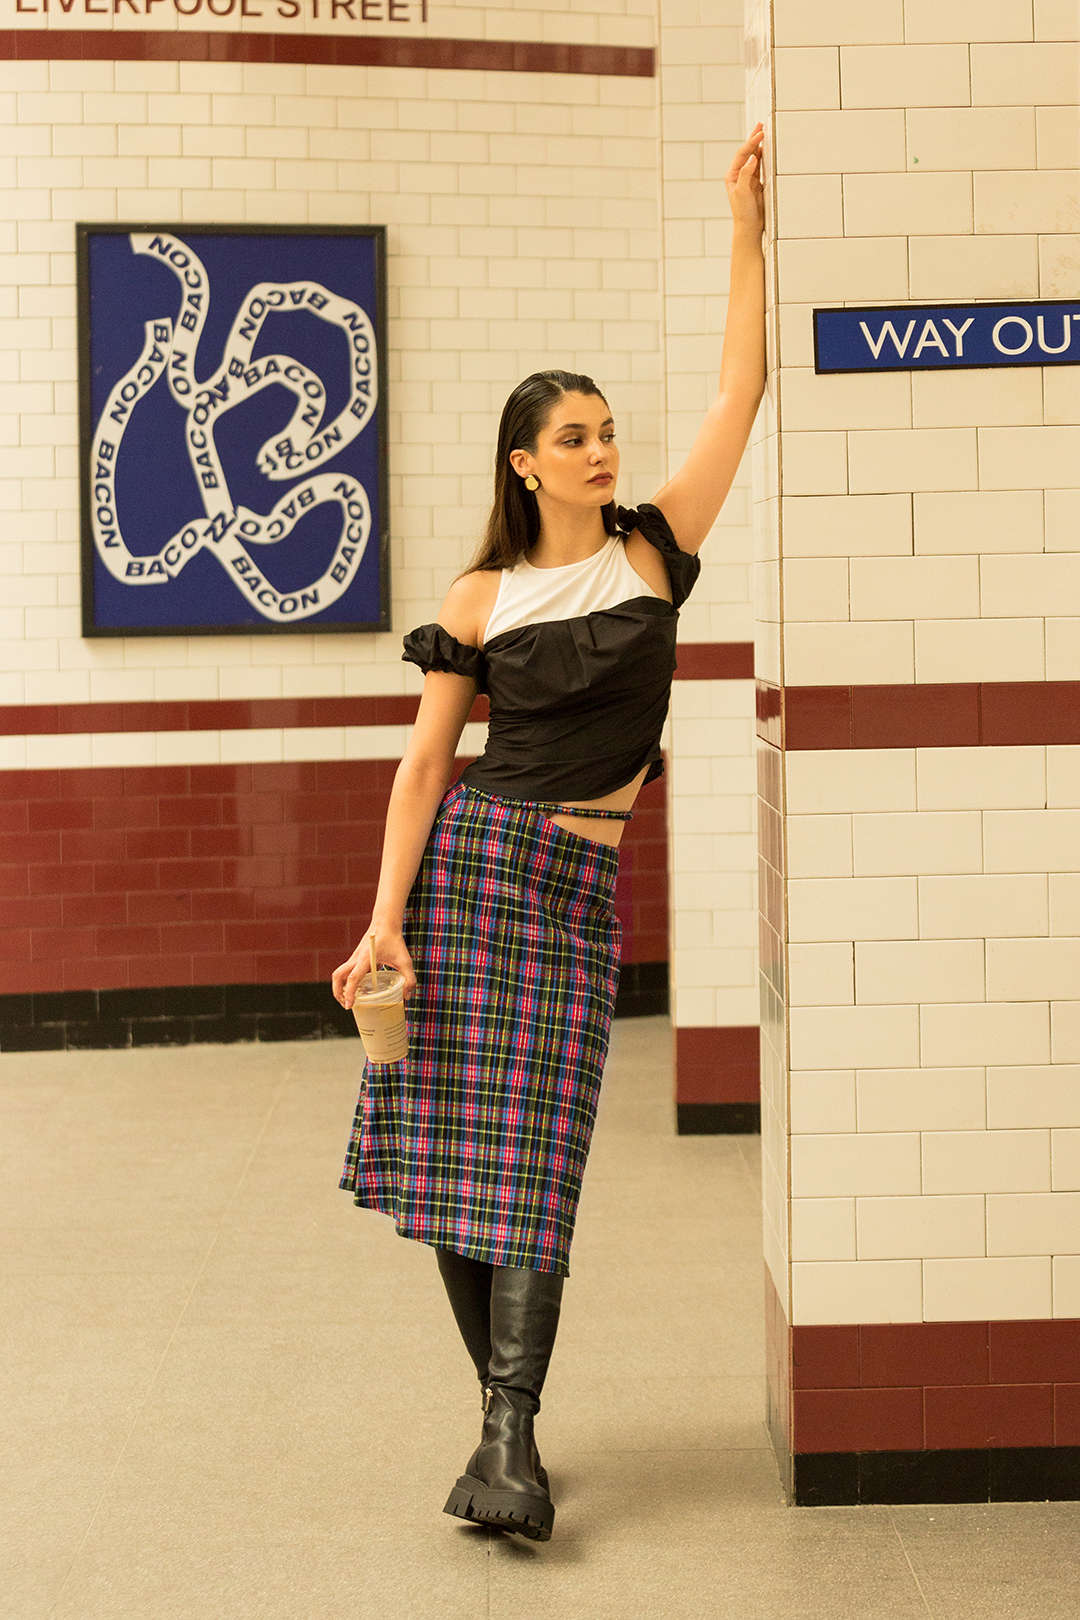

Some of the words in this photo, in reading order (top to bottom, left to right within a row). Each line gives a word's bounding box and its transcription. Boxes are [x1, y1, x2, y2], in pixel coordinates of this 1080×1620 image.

[149, 237, 202, 332] BACON
[240, 289, 329, 340] BACON
[110, 323, 169, 424] BACON
[343, 312, 371, 419] BACON
[859, 318, 975, 360] WAY
[243, 358, 324, 427] BACON
[95, 439, 119, 548] BACON
[330, 481, 363, 584] BACON
[231, 557, 320, 614] BACON
